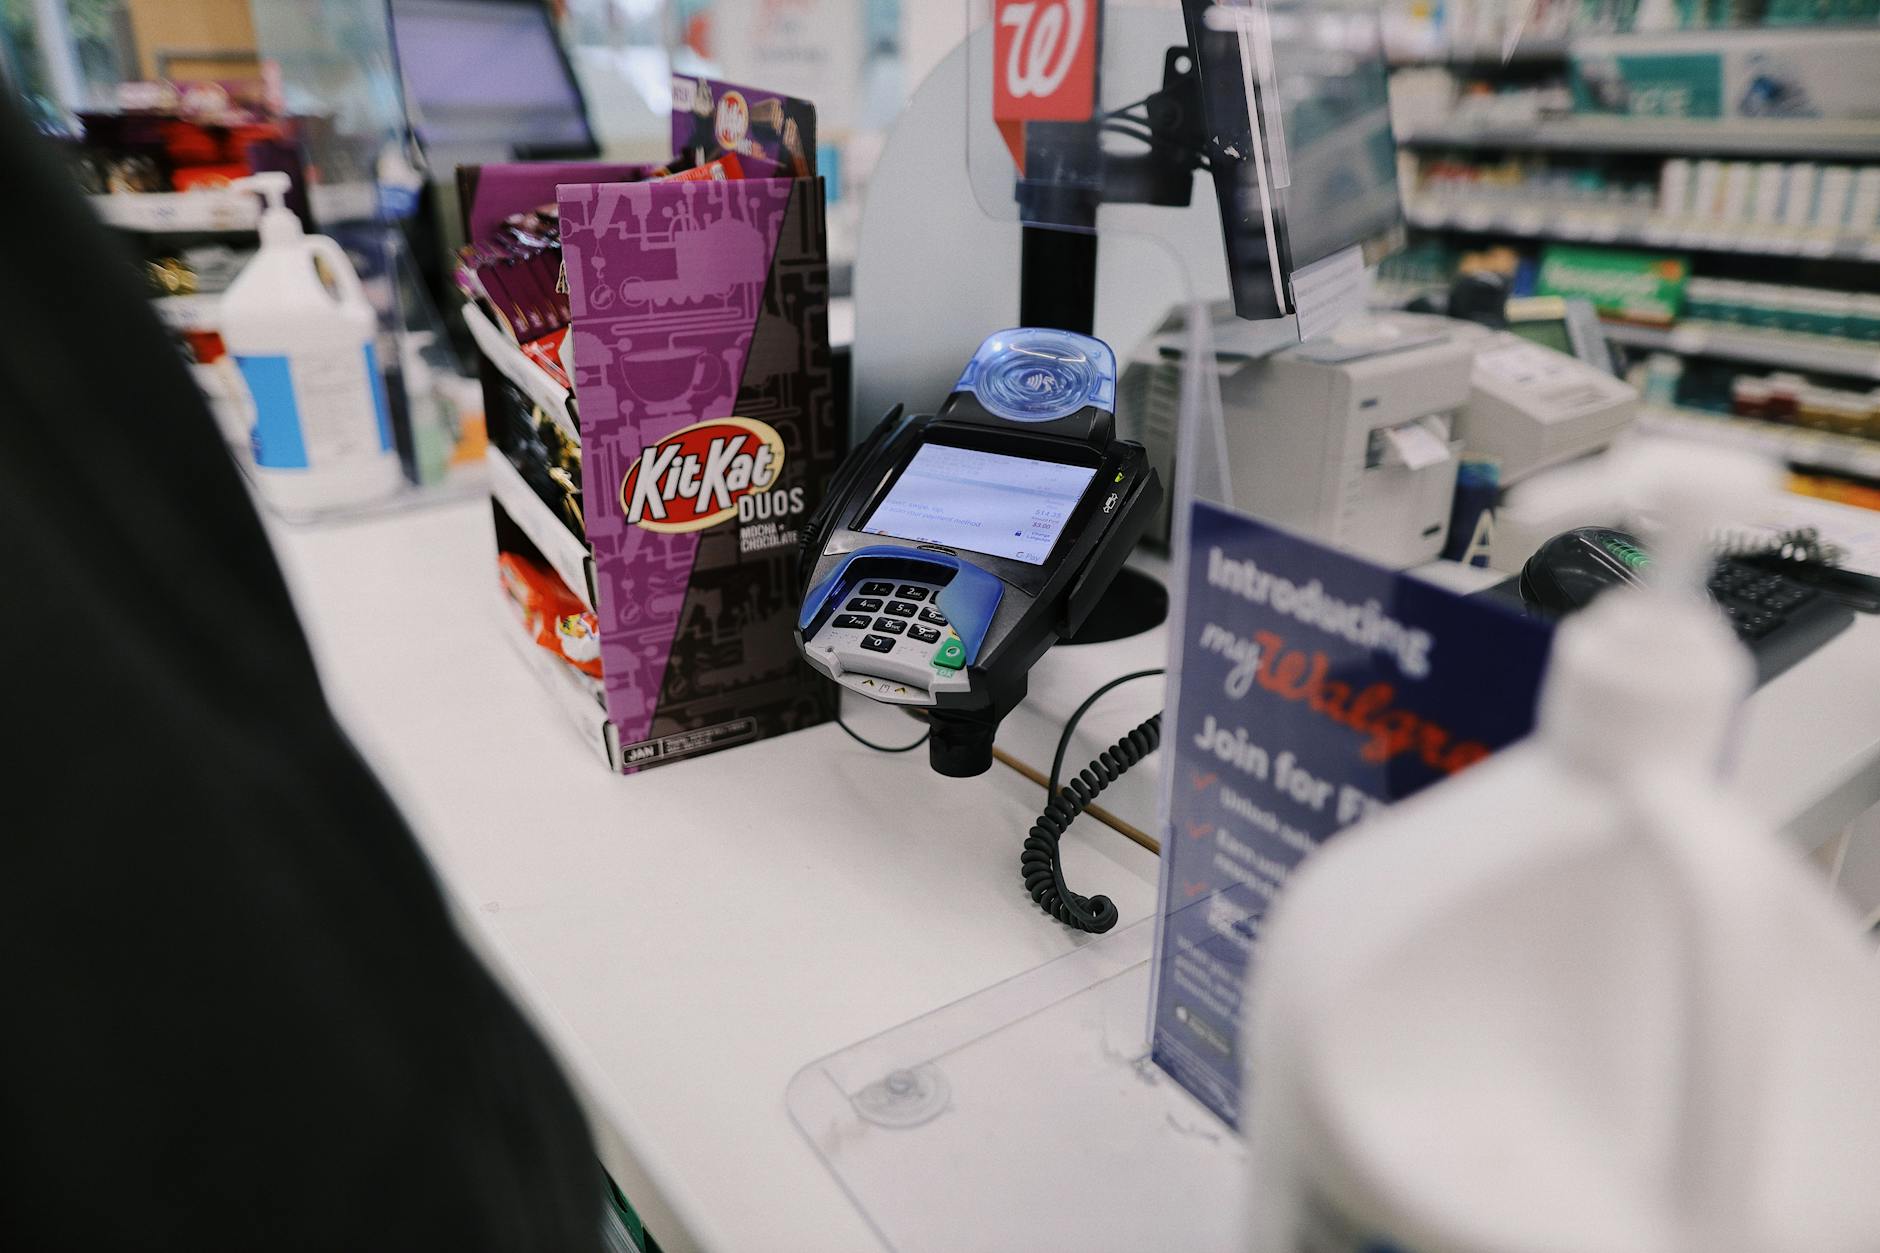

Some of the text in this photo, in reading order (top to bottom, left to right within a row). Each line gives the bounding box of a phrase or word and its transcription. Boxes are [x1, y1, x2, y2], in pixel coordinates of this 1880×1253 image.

[1000, 0, 1086, 98] W
[739, 487, 804, 523] DUOS
[906, 587, 915, 595] 2
[860, 599, 867, 607] 4
[896, 604, 904, 612] 5
[928, 611, 936, 619] 6
[1207, 546, 1434, 679] Introducing
[848, 616, 856, 624] 7
[885, 620, 893, 628] 8
[918, 627, 926, 635] 9
[873, 638, 881, 646] 0
[628, 745, 655, 761] JAN
[1194, 715, 1269, 780] Join
[1274, 751, 1334, 811] for
